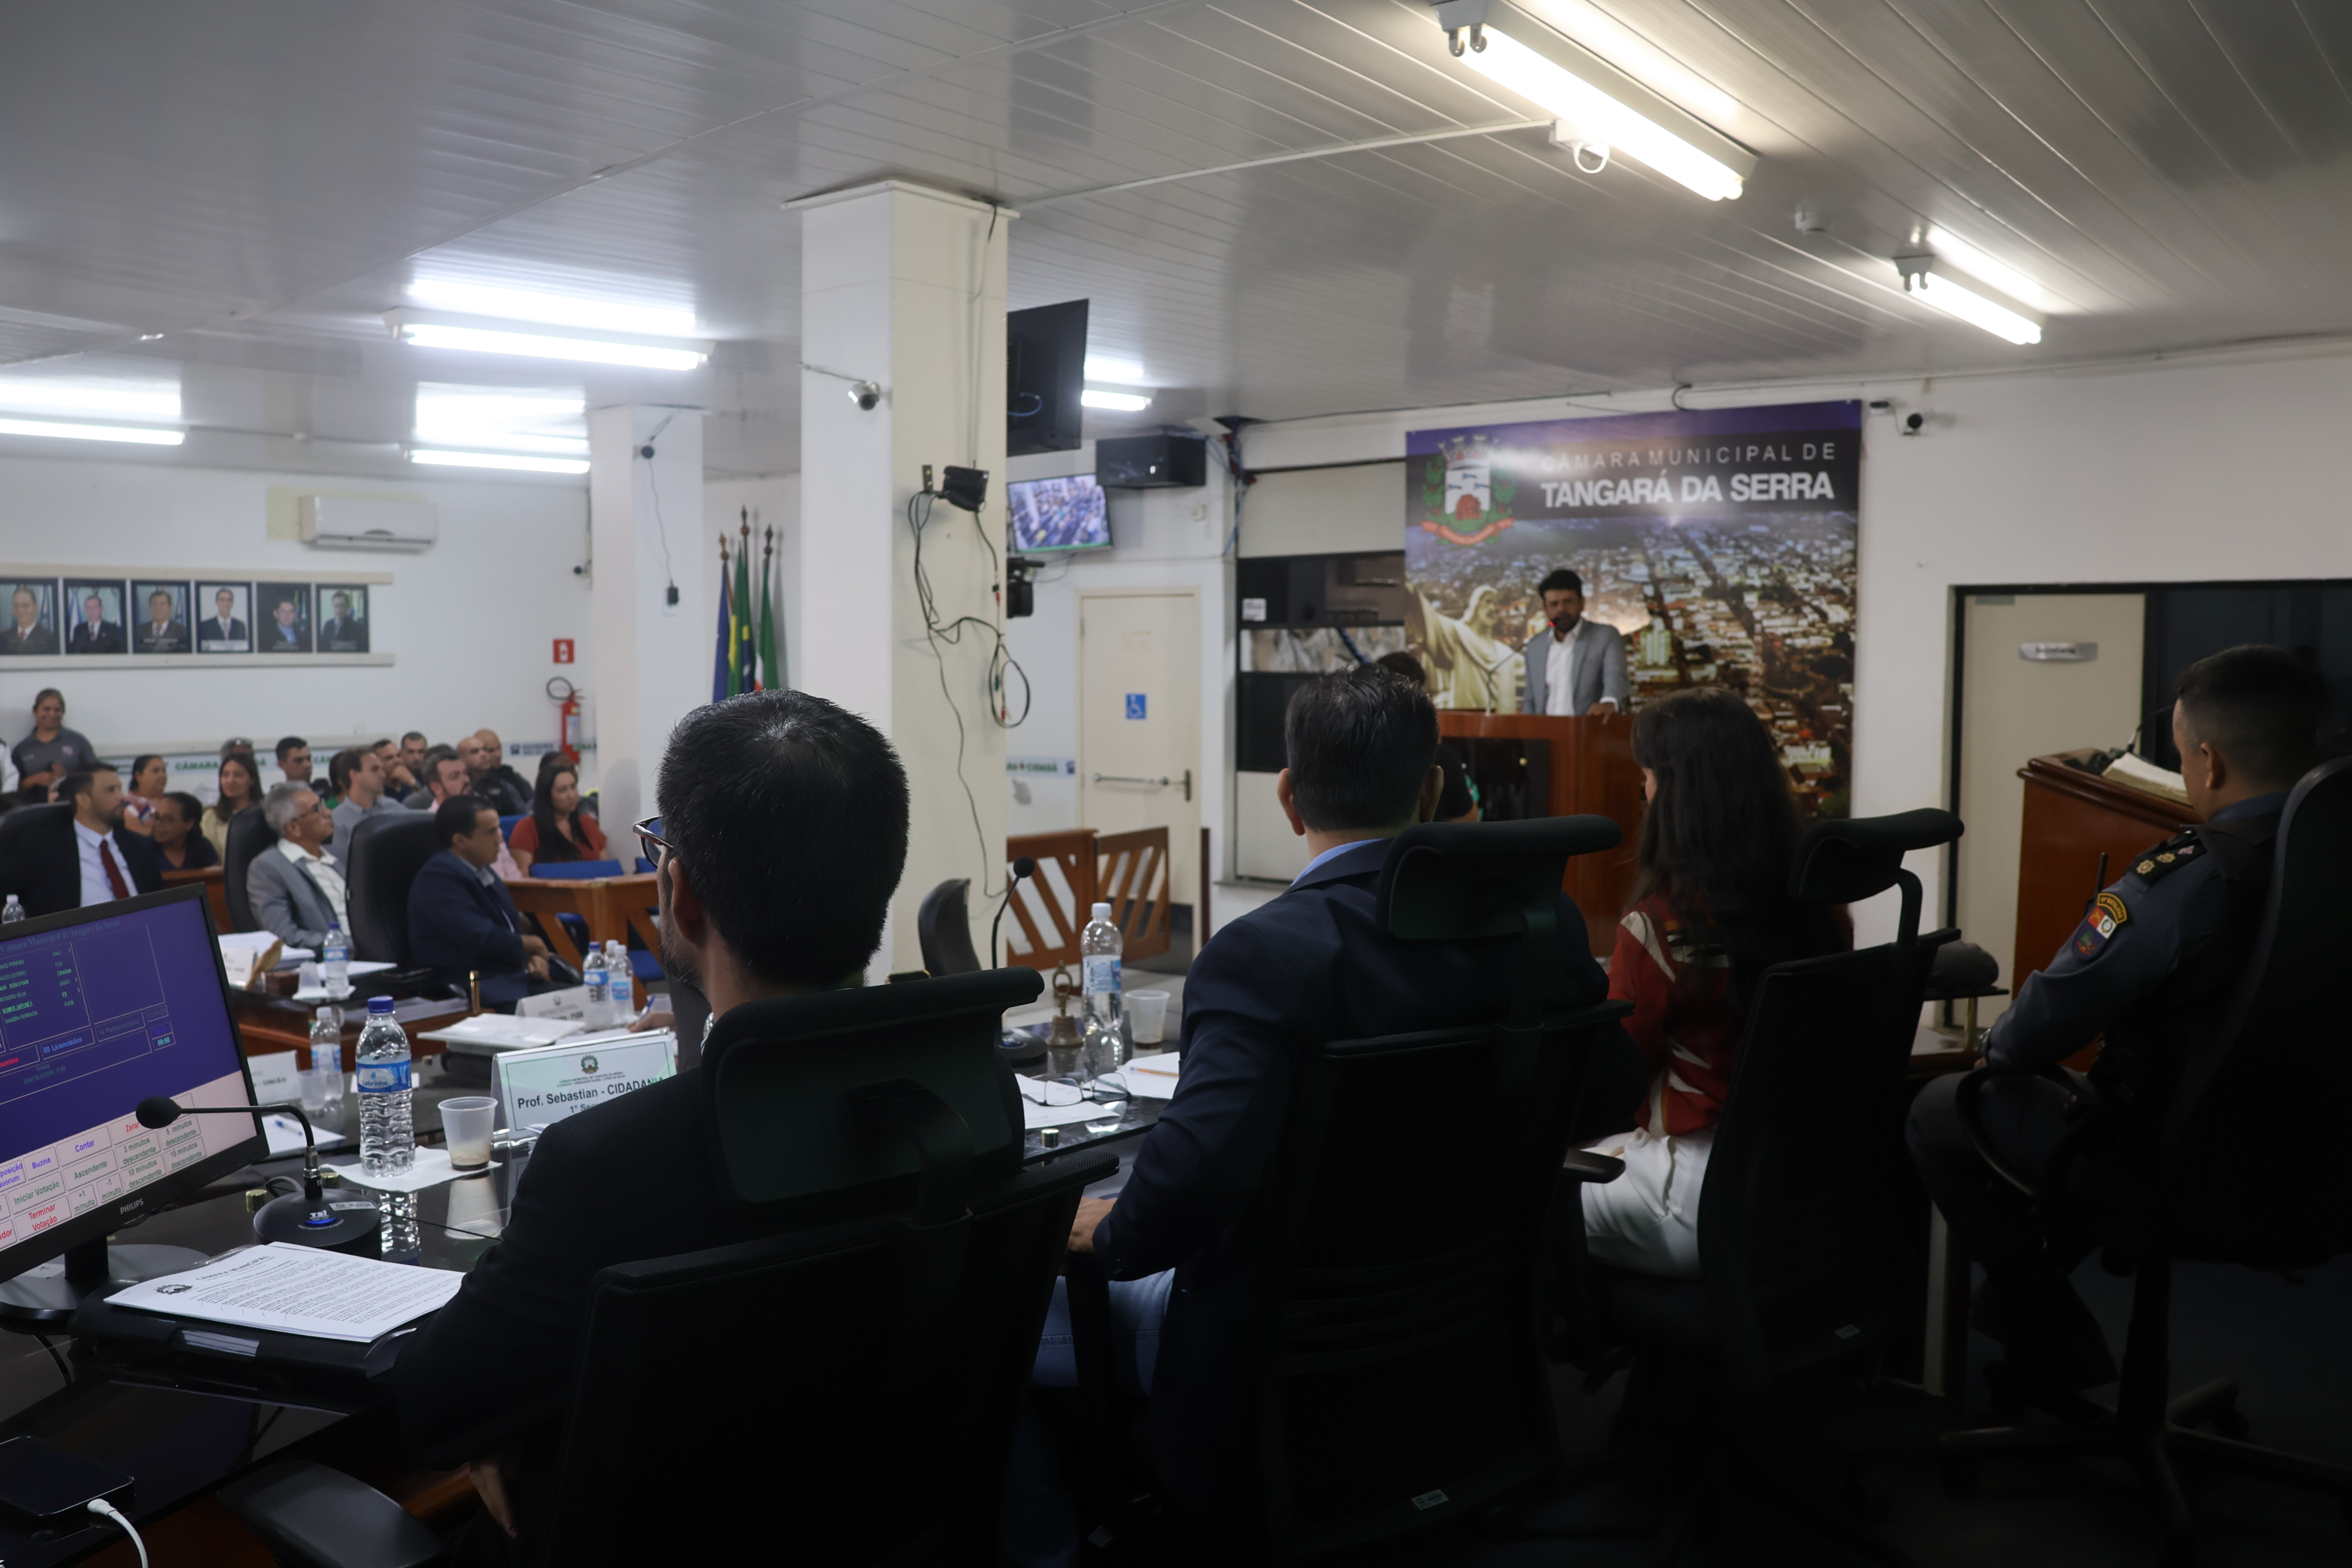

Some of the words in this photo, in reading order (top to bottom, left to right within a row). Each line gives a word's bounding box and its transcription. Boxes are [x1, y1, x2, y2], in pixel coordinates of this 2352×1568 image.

[1541, 451, 1640, 472] CÂMARA
[1649, 444, 1793, 466] MUNICIPAL
[1803, 443, 1836, 461] DE
[1541, 469, 1673, 508] TANGARÁ
[1681, 475, 1724, 503] DA
[1730, 471, 1836, 501] SERRA
[51, 1037, 83, 1051] Licenciados
[158, 1036, 170, 1046] 00:00
[518, 1095, 544, 1109] Prof.
[547, 1088, 598, 1105] Sebastian
[171, 1120, 192, 1133] minutos
[128, 1138, 151, 1151] minutos
[165, 1129, 197, 1147] descendente
[74, 1139, 95, 1152] Contar
[177, 1142, 198, 1155] minutos
[123, 1146, 156, 1165] descendente
[171, 1151, 202, 1169] descendente
[32, 1157, 51, 1169] Buzina
[74, 1160, 108, 1180] Ascendente
[135, 1160, 158, 1174] minutos
[0, 1163, 23, 1178] posição
[0, 1176, 20, 1188] uorum
[129, 1169, 162, 1188] descendente
[14, 1192, 34, 1205] Iniciar
[34, 1180, 60, 1196] Votação
[78, 1190, 86, 1198] +1
[102, 1187, 122, 1201] minuto
[28, 1203, 56, 1220] Terminar
[74, 1199, 96, 1213] minuto
[120, 1198, 144, 1215] PHILIPS
[32, 1216, 58, 1232] Votação
[0, 1229, 13, 1240] ador
